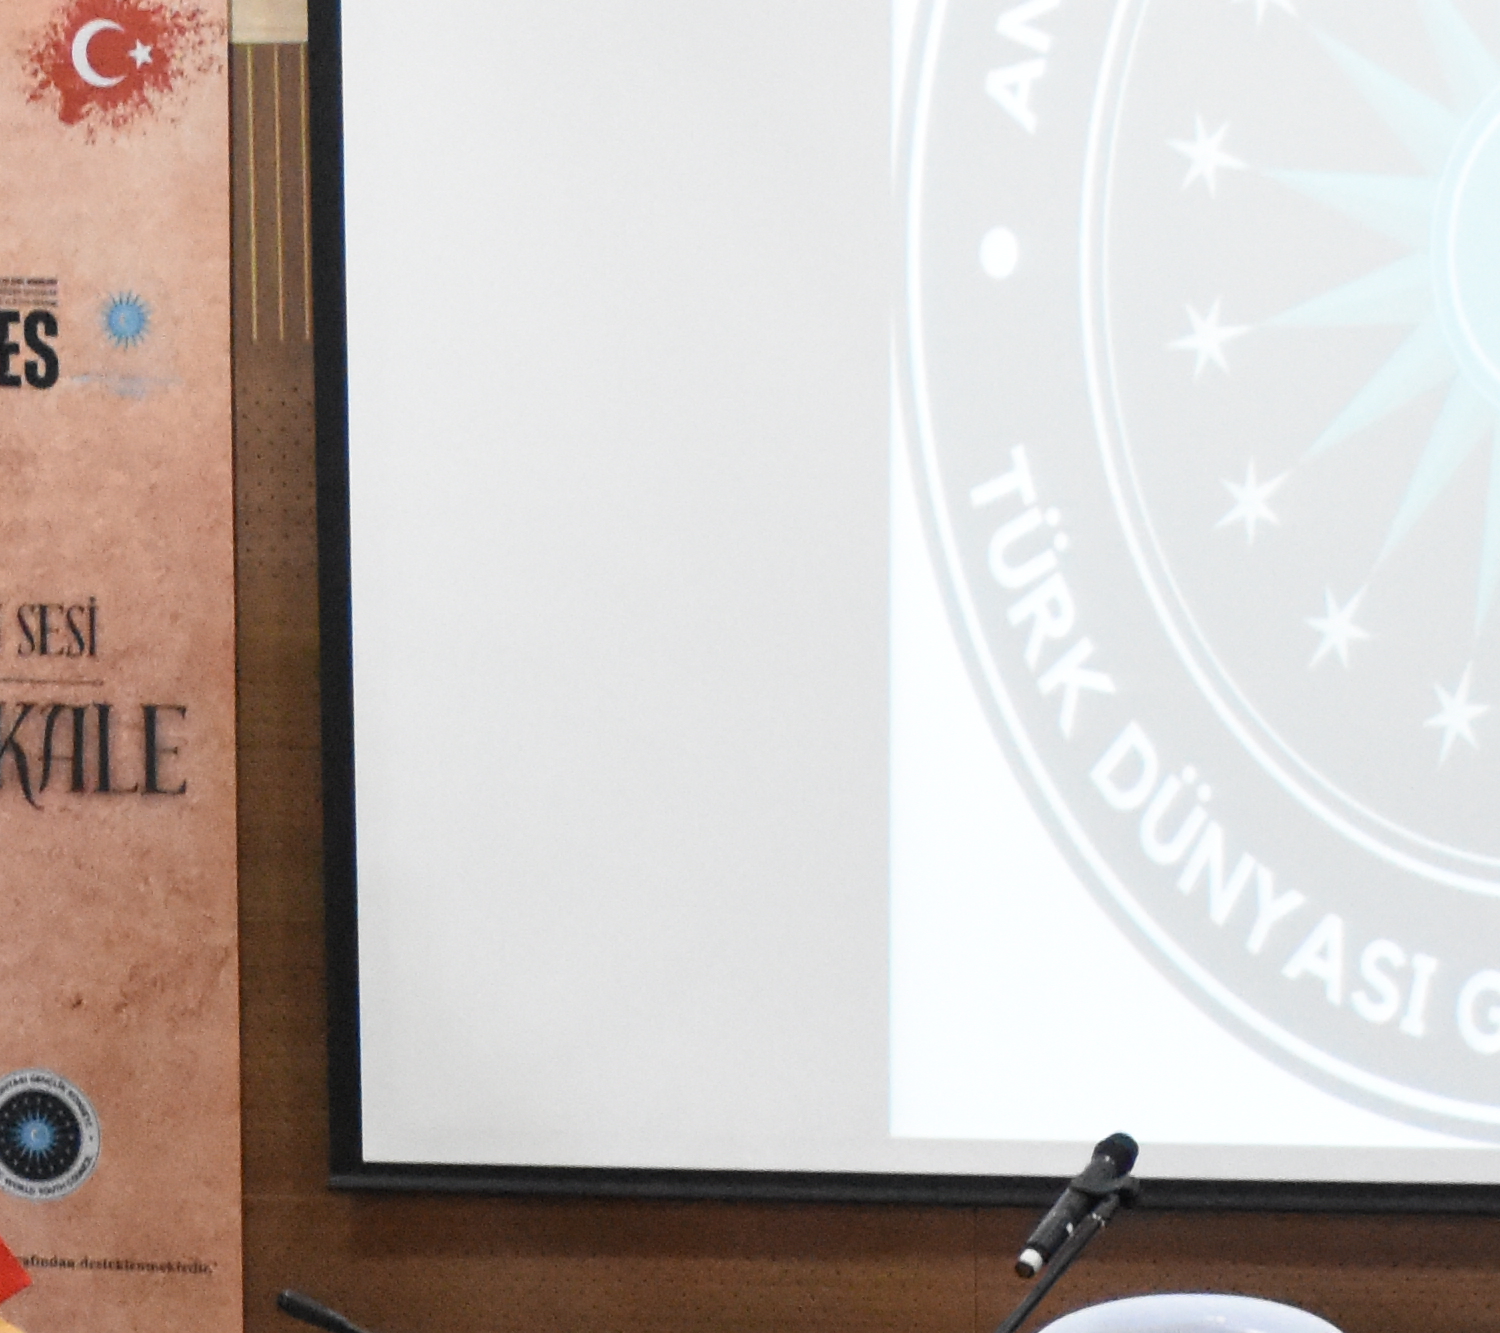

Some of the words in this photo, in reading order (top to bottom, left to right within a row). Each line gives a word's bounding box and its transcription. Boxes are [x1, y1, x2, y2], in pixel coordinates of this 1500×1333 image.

[17, 596, 98, 658] SESİ
[969, 442, 1117, 742] TÜRK
[1088, 719, 1440, 1039] DÜNYASI
